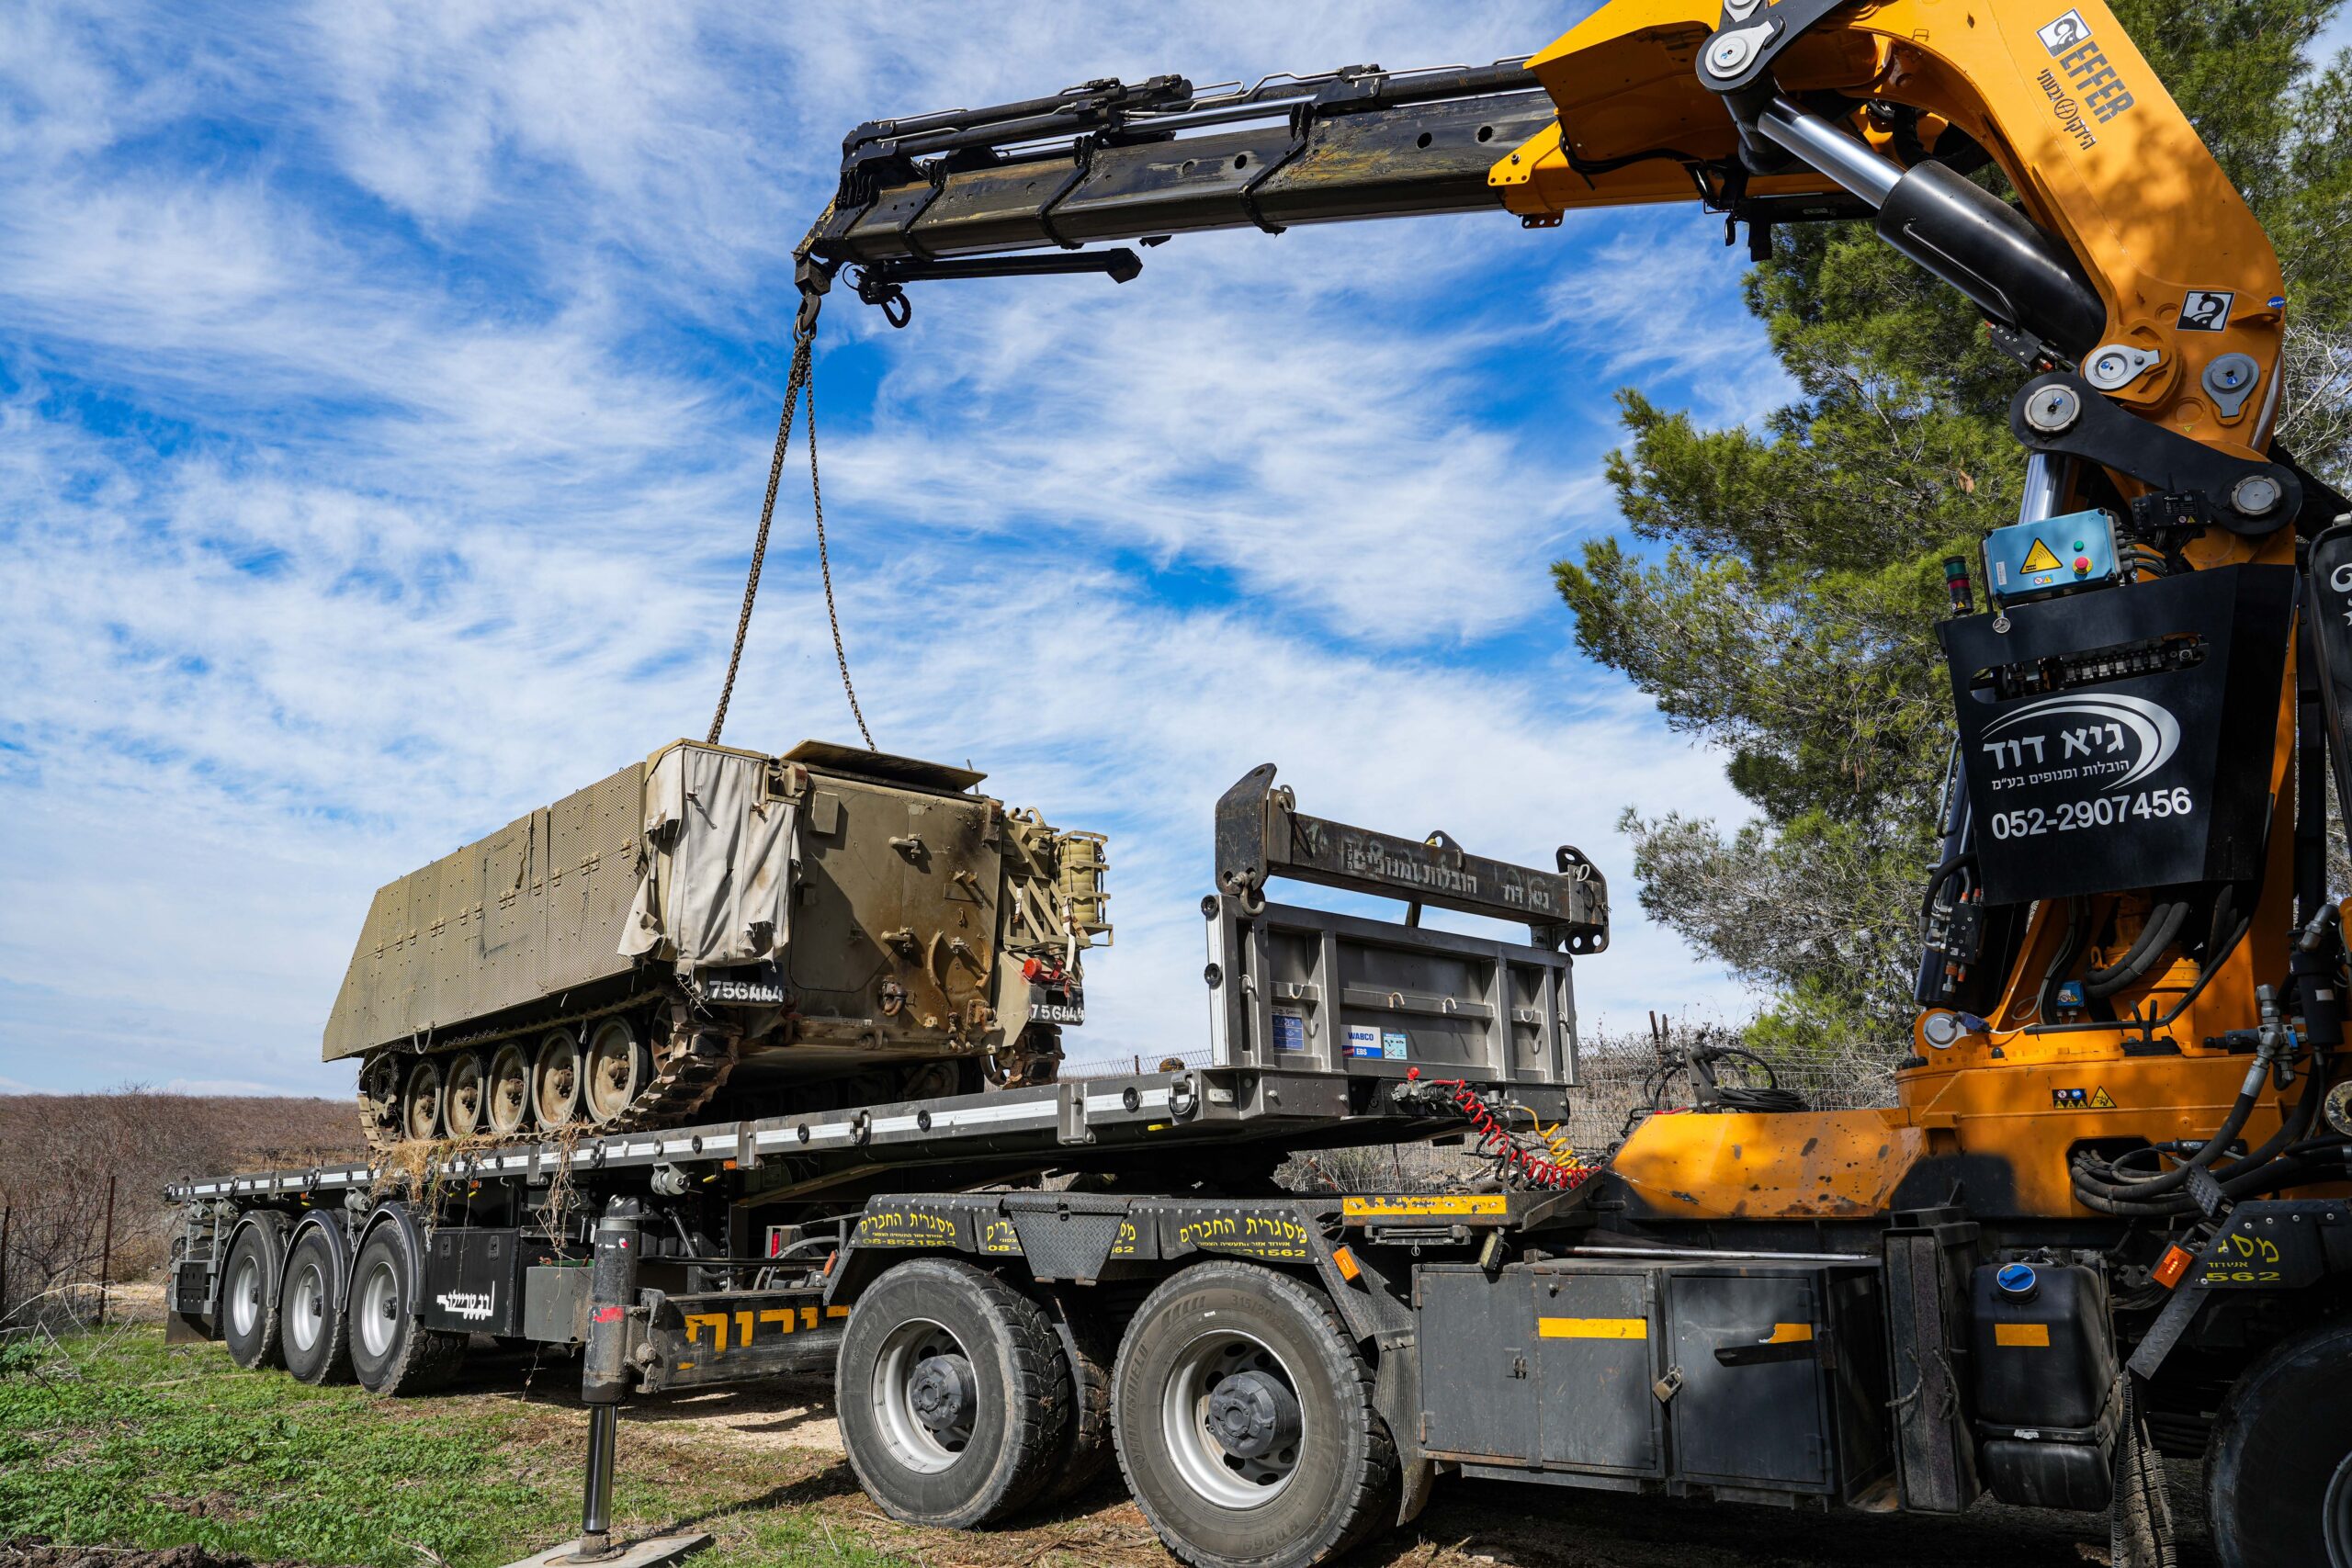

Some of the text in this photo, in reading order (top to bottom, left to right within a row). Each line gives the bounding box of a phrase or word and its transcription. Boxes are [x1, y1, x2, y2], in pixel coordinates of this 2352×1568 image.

[2059, 40, 2135, 125] EFFER
[1983, 723, 2125, 770] גיא דוד
[2029, 768, 2078, 784] ומנופים
[2083, 760, 2130, 777] הובלות
[1991, 786, 2192, 840] 052-2907456
[709, 980, 784, 1002] 756444
[1031, 1004, 1085, 1021] 756444
[1347, 1032, 1374, 1042] WABCO
[860, 1213, 956, 1236] מסגרית החברים
[1180, 1217, 1308, 1244] מסגרית החברים
